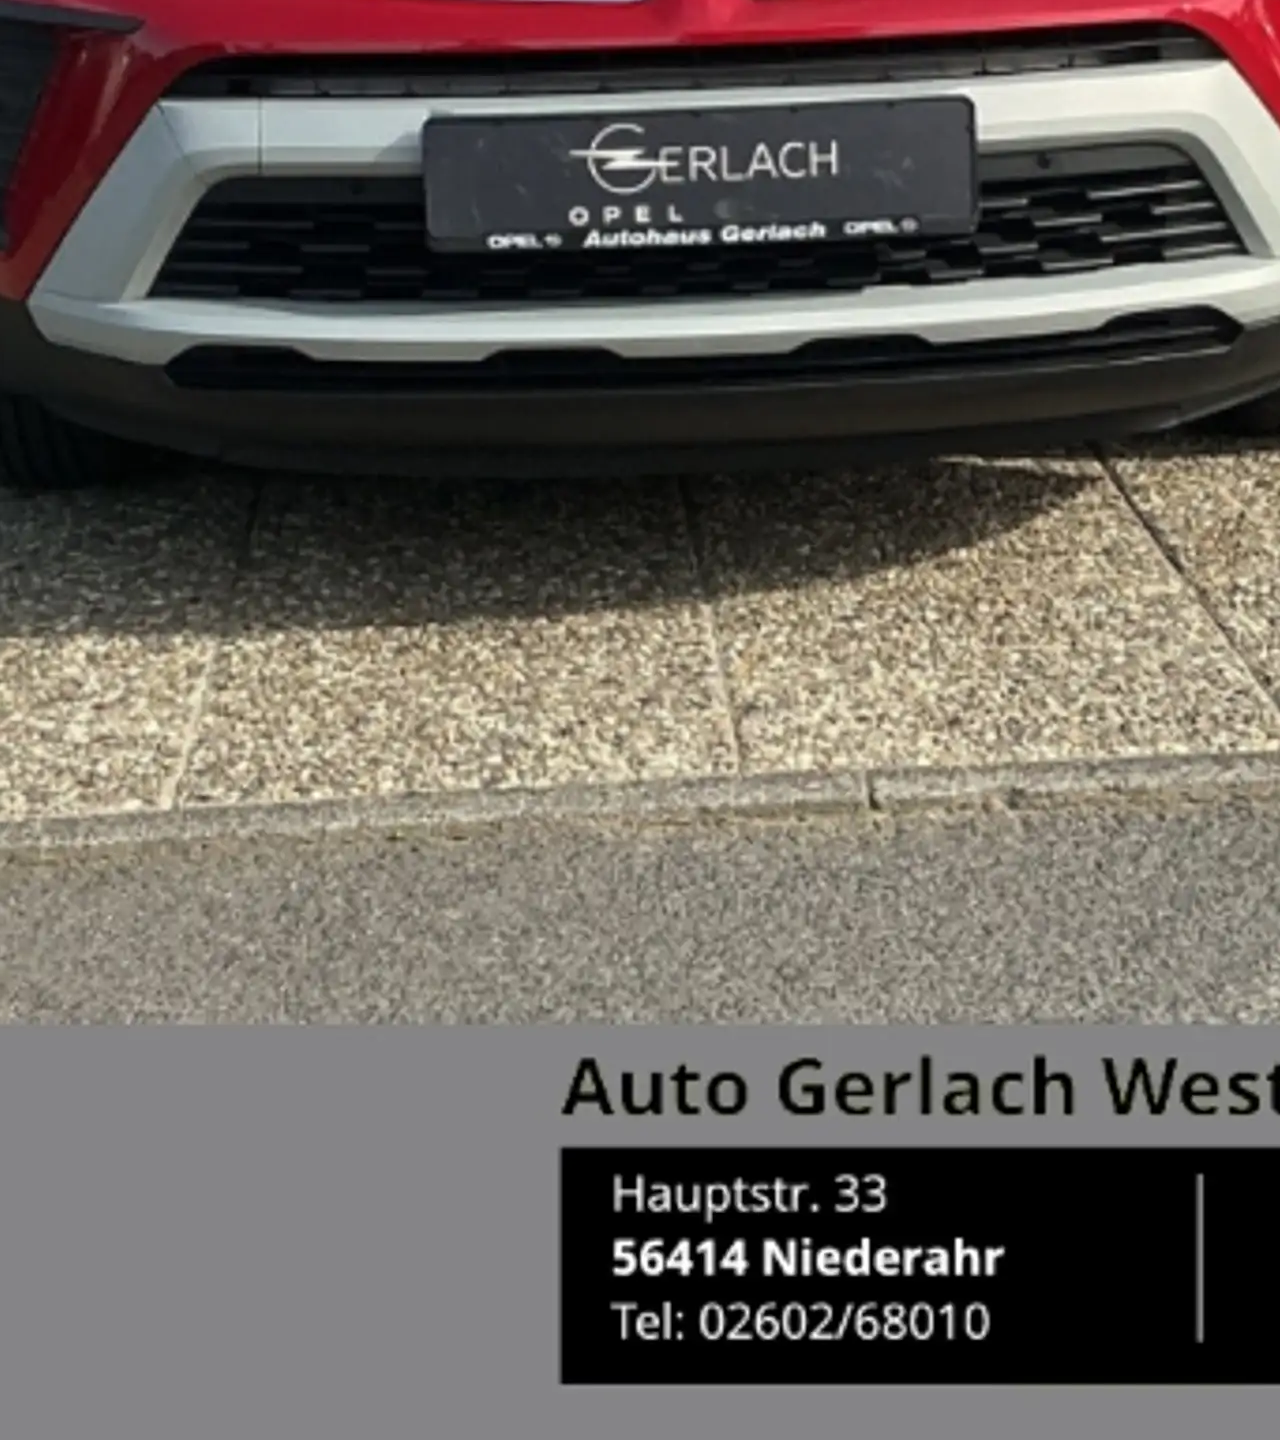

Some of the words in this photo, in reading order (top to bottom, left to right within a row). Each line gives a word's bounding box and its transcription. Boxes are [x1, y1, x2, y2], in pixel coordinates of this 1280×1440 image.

[568, 204, 684, 227] OPEL
[582, 227, 712, 249] Autohaus
[721, 220, 827, 244] Gerlach
